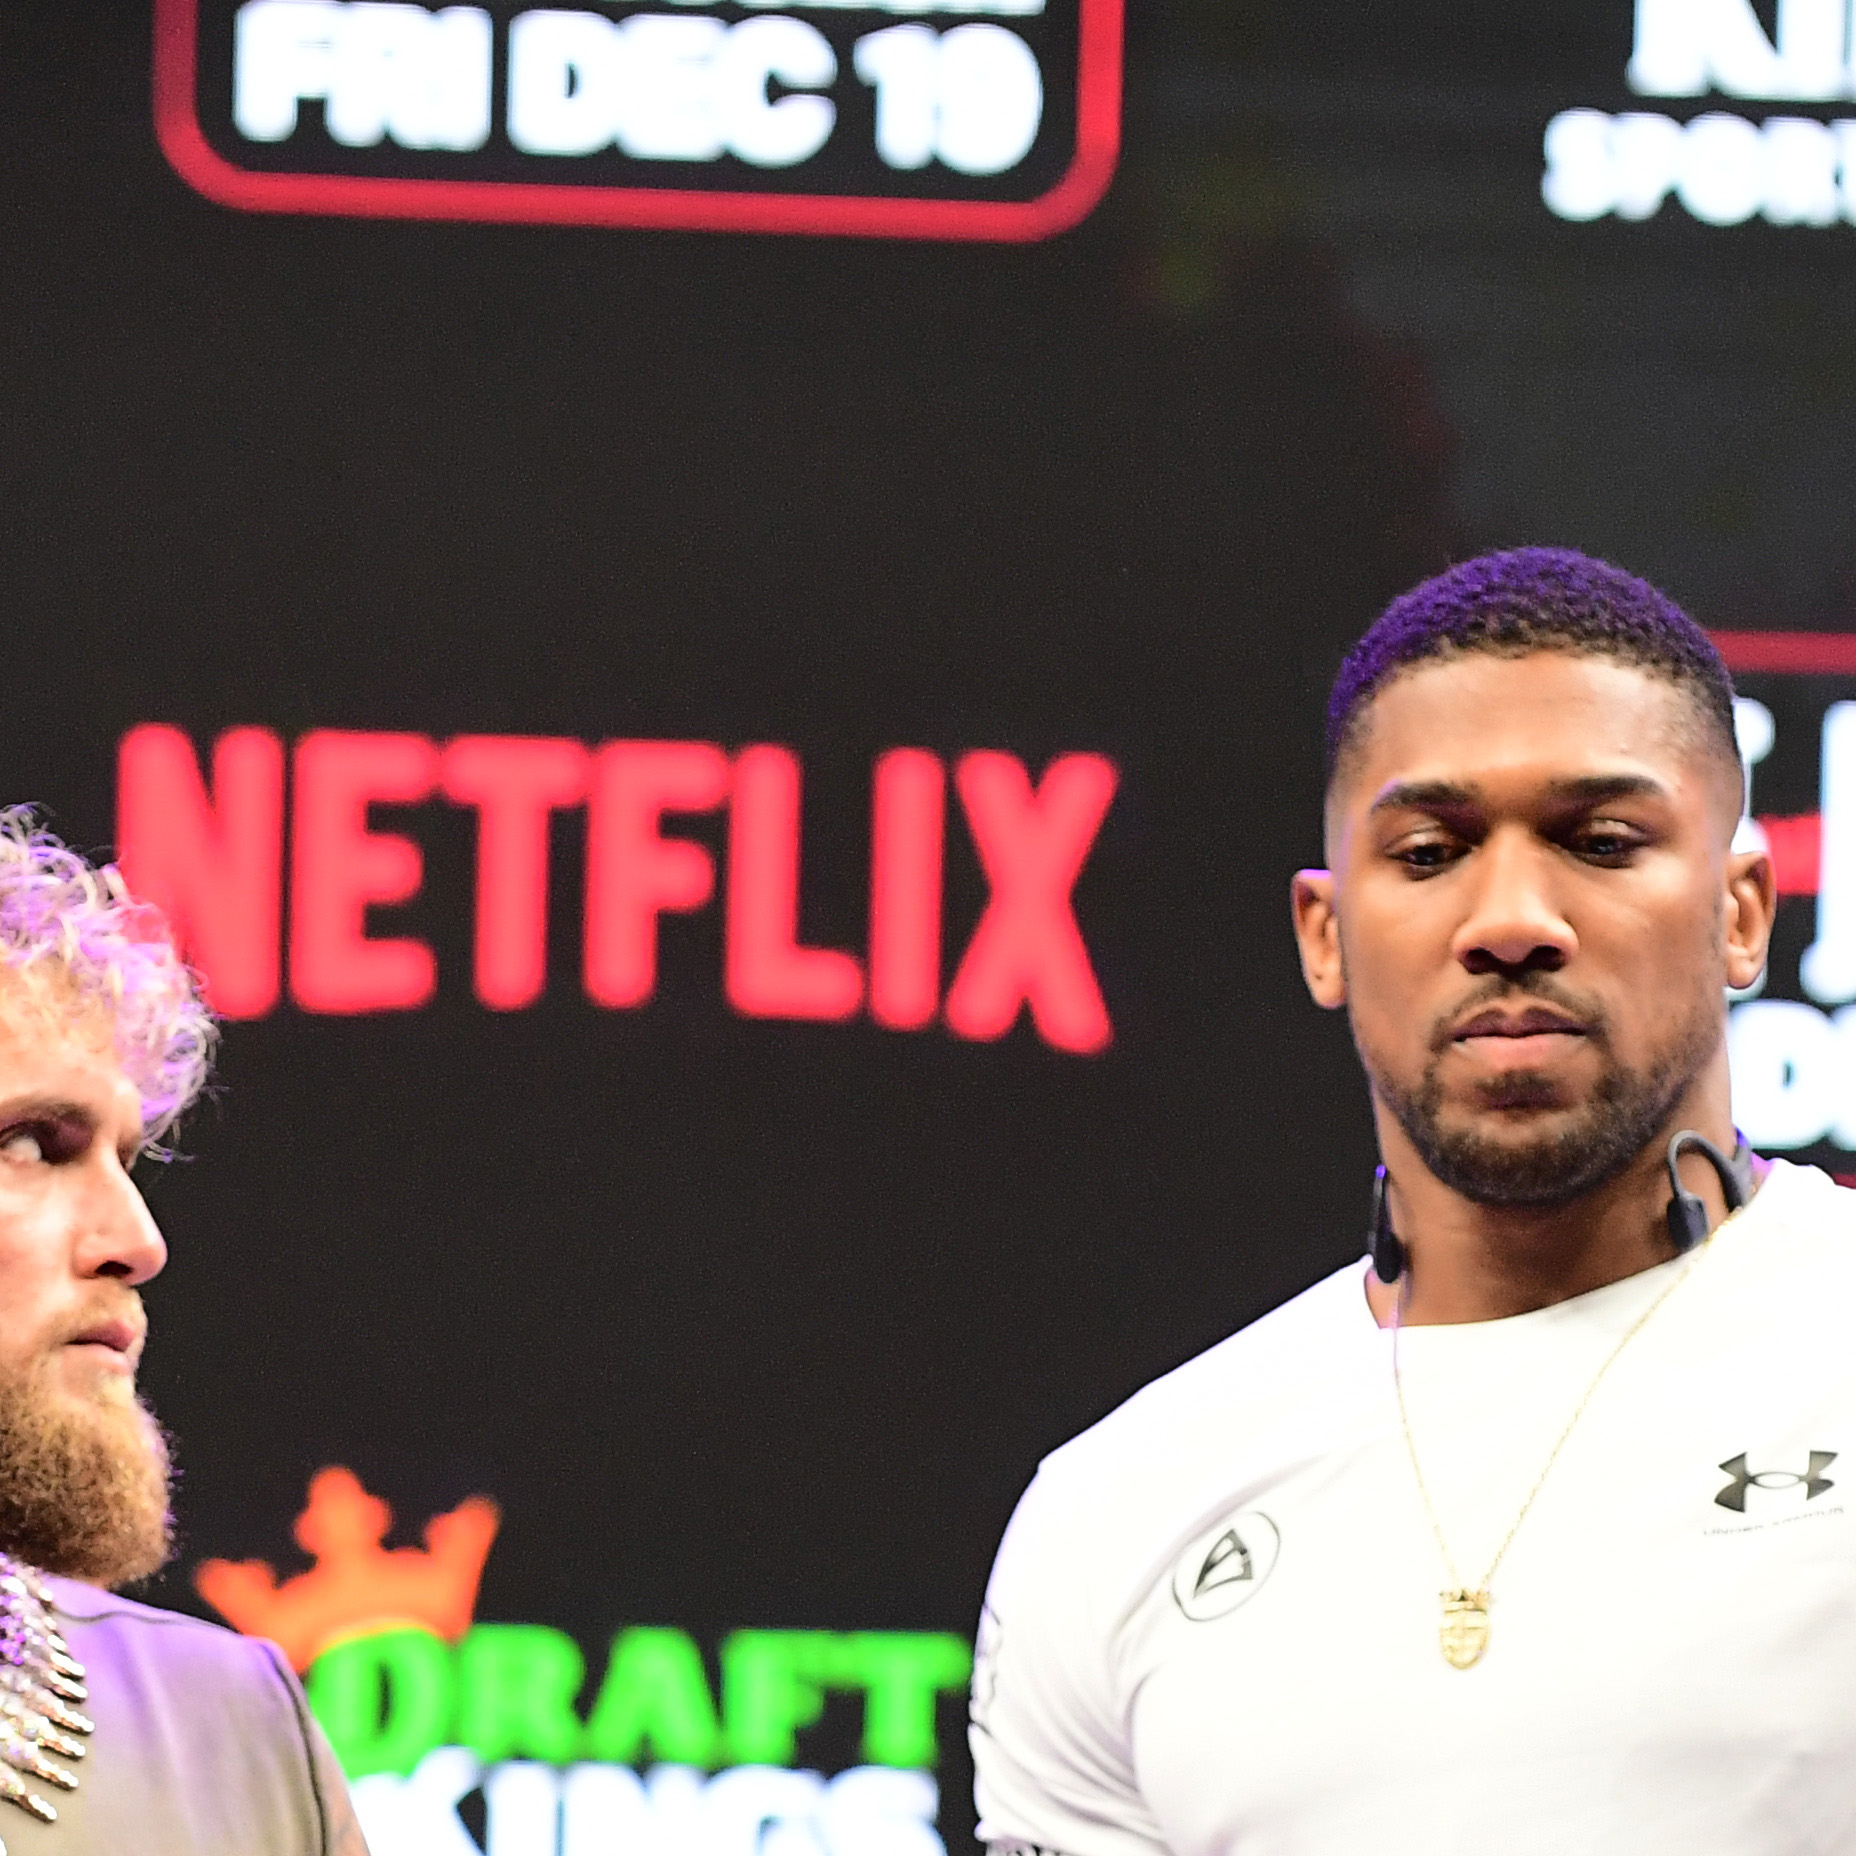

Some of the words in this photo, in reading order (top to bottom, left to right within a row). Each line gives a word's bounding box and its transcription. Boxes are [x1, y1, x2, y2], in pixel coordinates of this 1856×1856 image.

[506, 10, 838, 168] DEC
[116, 722, 1120, 1054] NETFLIX
[306, 1622, 972, 1782] DRAFT
